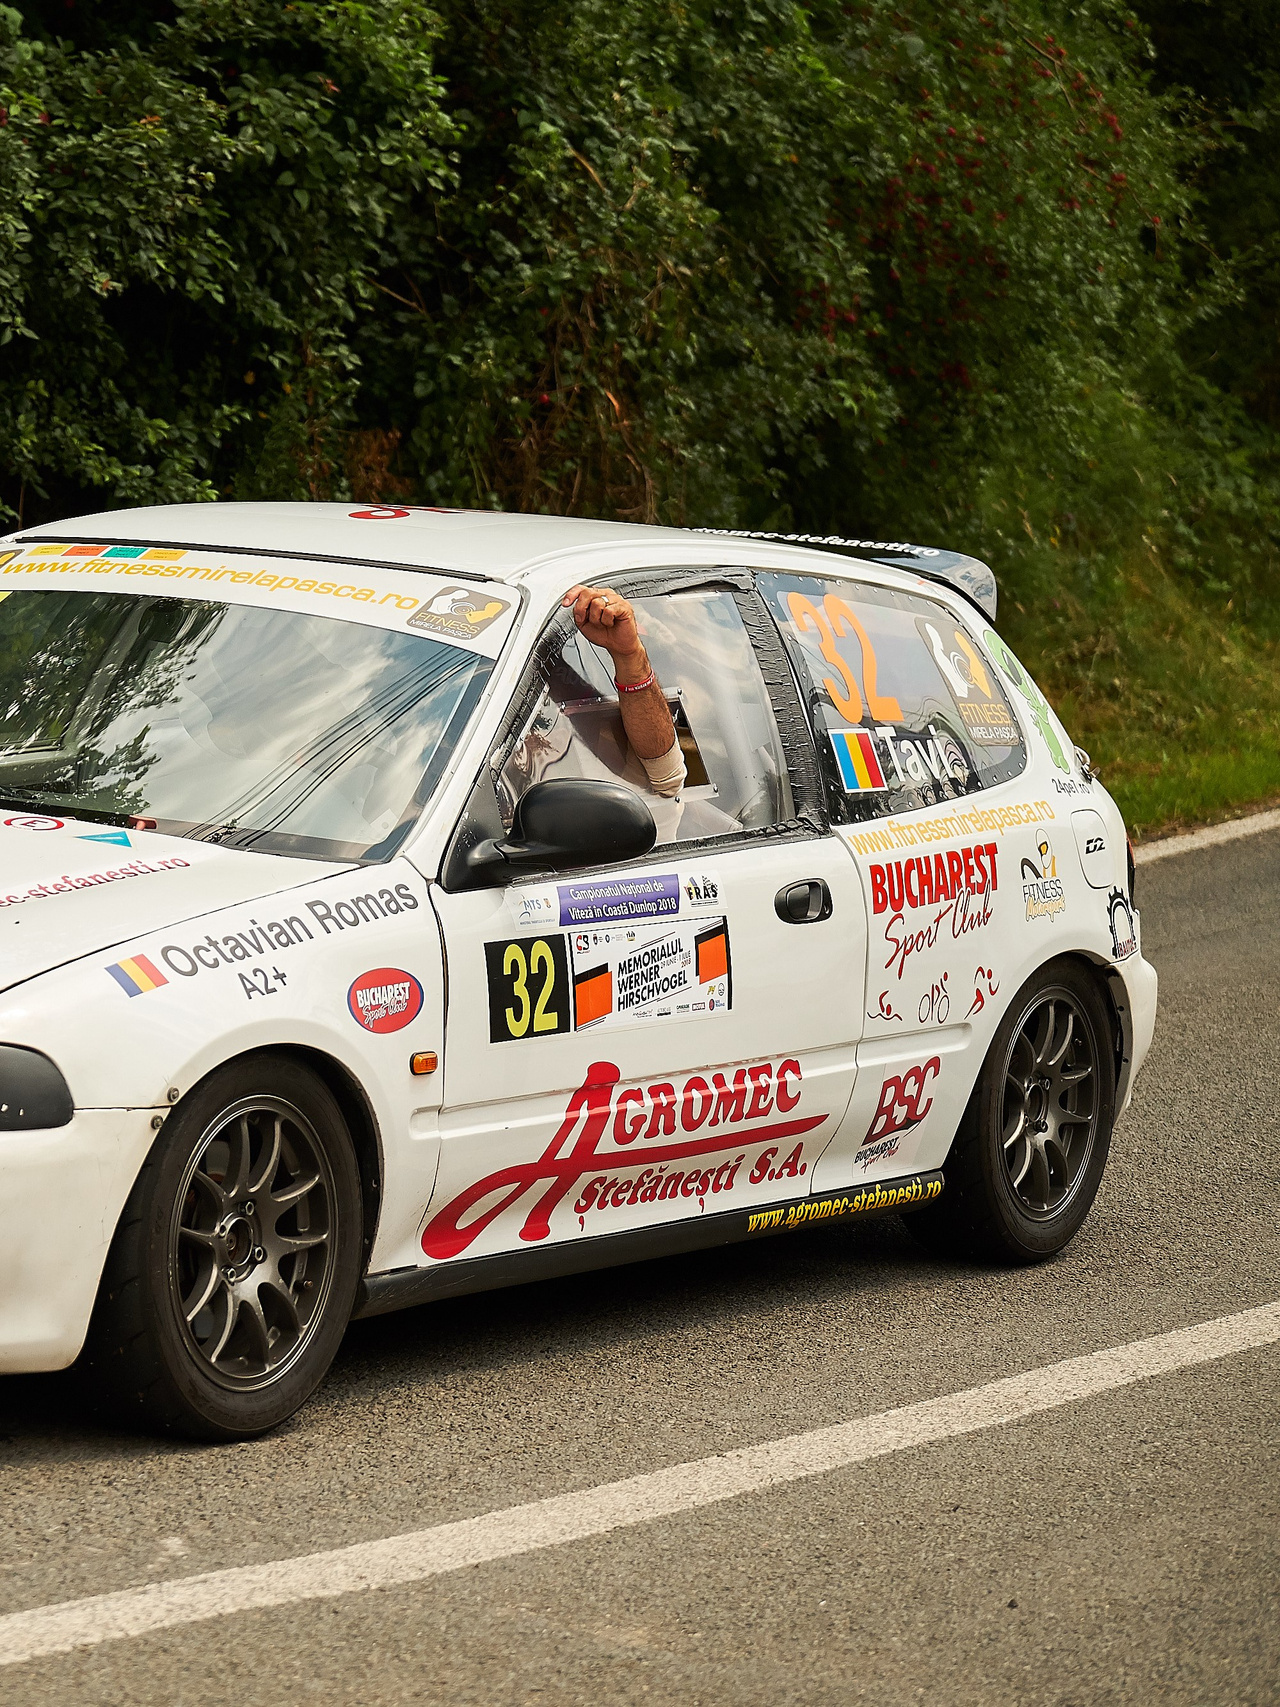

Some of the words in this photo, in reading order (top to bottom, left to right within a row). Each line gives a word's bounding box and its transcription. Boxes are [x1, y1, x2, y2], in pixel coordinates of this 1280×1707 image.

[3, 557, 419, 611] www.fitnessmirelapasca.ro
[409, 619, 441, 631] MIRELA
[415, 612, 480, 634] FITNESS
[787, 592, 905, 724] 32
[959, 703, 1011, 724] FITNESS
[968, 726, 996, 739] MIRELA
[874, 725, 955, 782] Tavi
[846, 800, 1056, 856] www.fitnessmirelapasca.ro
[569, 885, 621, 901] Campionatul
[653, 879, 665, 892] de
[686, 884, 718, 901] FRAS
[869, 841, 999, 914] BUCHAREST
[1022, 878, 1064, 903] FITNESS
[628, 899, 658, 915] Dunlop
[657, 897, 677, 911] 2018
[161, 918, 315, 977] Octavian
[304, 883, 419, 934] Romas
[884, 903, 954, 980] Sport
[951, 879, 994, 940] Club
[617, 938, 684, 979] MEMORIALUL
[680, 958, 691, 968] 2018
[236, 965, 288, 1000] A2+
[356, 981, 411, 1008] BUCHAREST
[503, 939, 559, 1038] 32
[618, 964, 661, 995] WERNER
[618, 969, 688, 1012] HIRSCHVOGEL
[860, 1055, 941, 1146] BSC
[421, 1060, 803, 1259] AGROMEC
[748, 1141, 808, 1184] S.A.
[853, 1136, 900, 1164] BUCHAREST
[746, 1176, 943, 1233] www.agromec-stefanesti.ro
